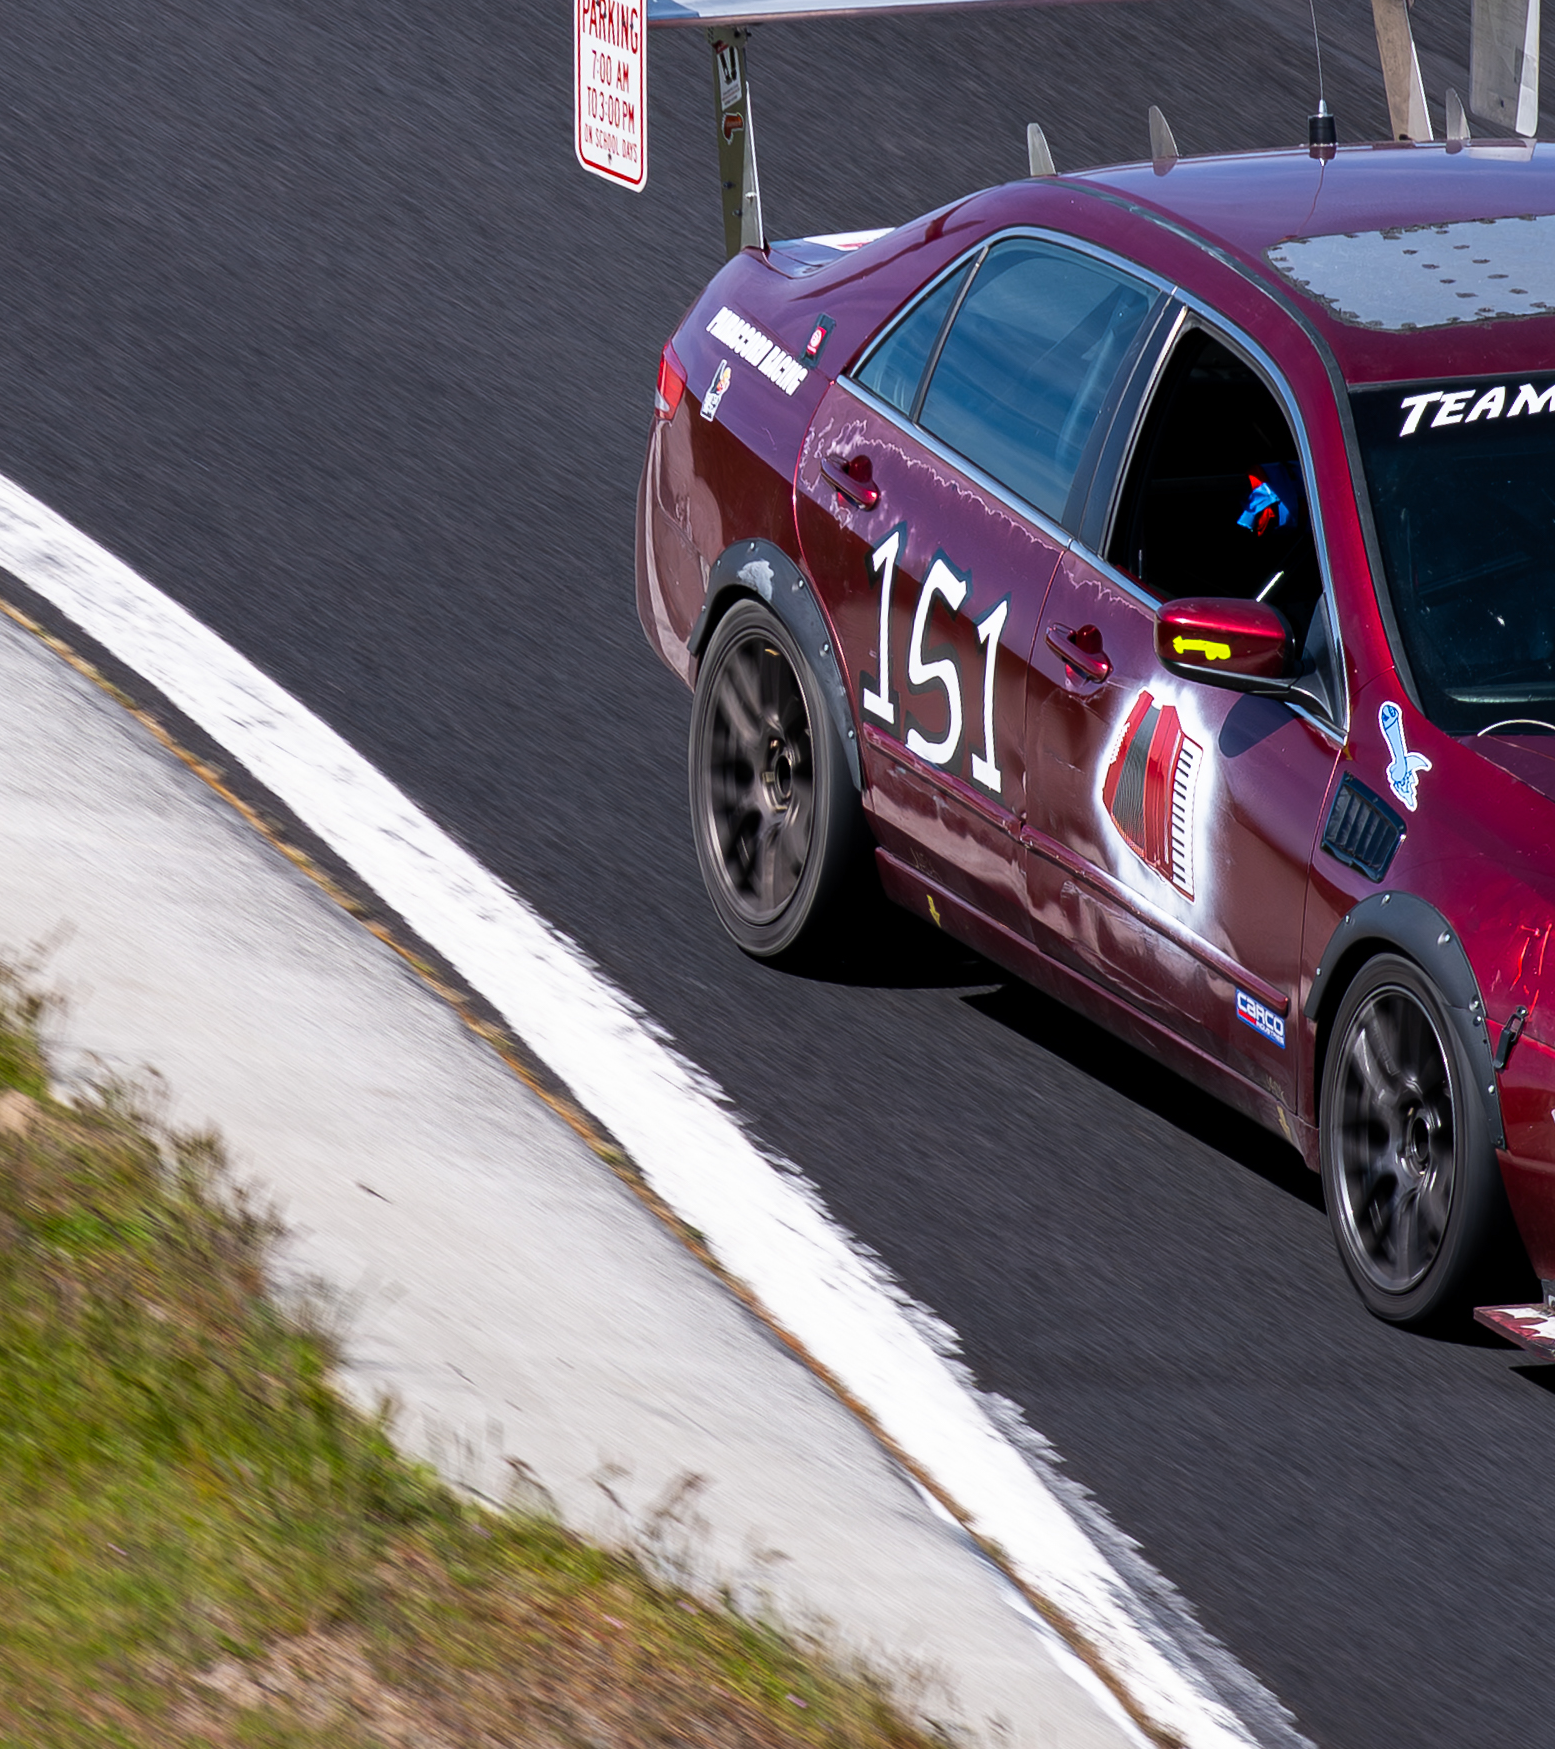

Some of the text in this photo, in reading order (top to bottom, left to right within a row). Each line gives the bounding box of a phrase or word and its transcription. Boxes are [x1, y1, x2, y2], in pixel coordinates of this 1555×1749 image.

[591, 49, 630, 94] 7:00 AM
[587, 85, 636, 134] TO 3:00 PM
[584, 122, 638, 163] ON SCHOOL DAYS
[757, 345, 809, 397] RACING
[861, 528, 1010, 796] 151
